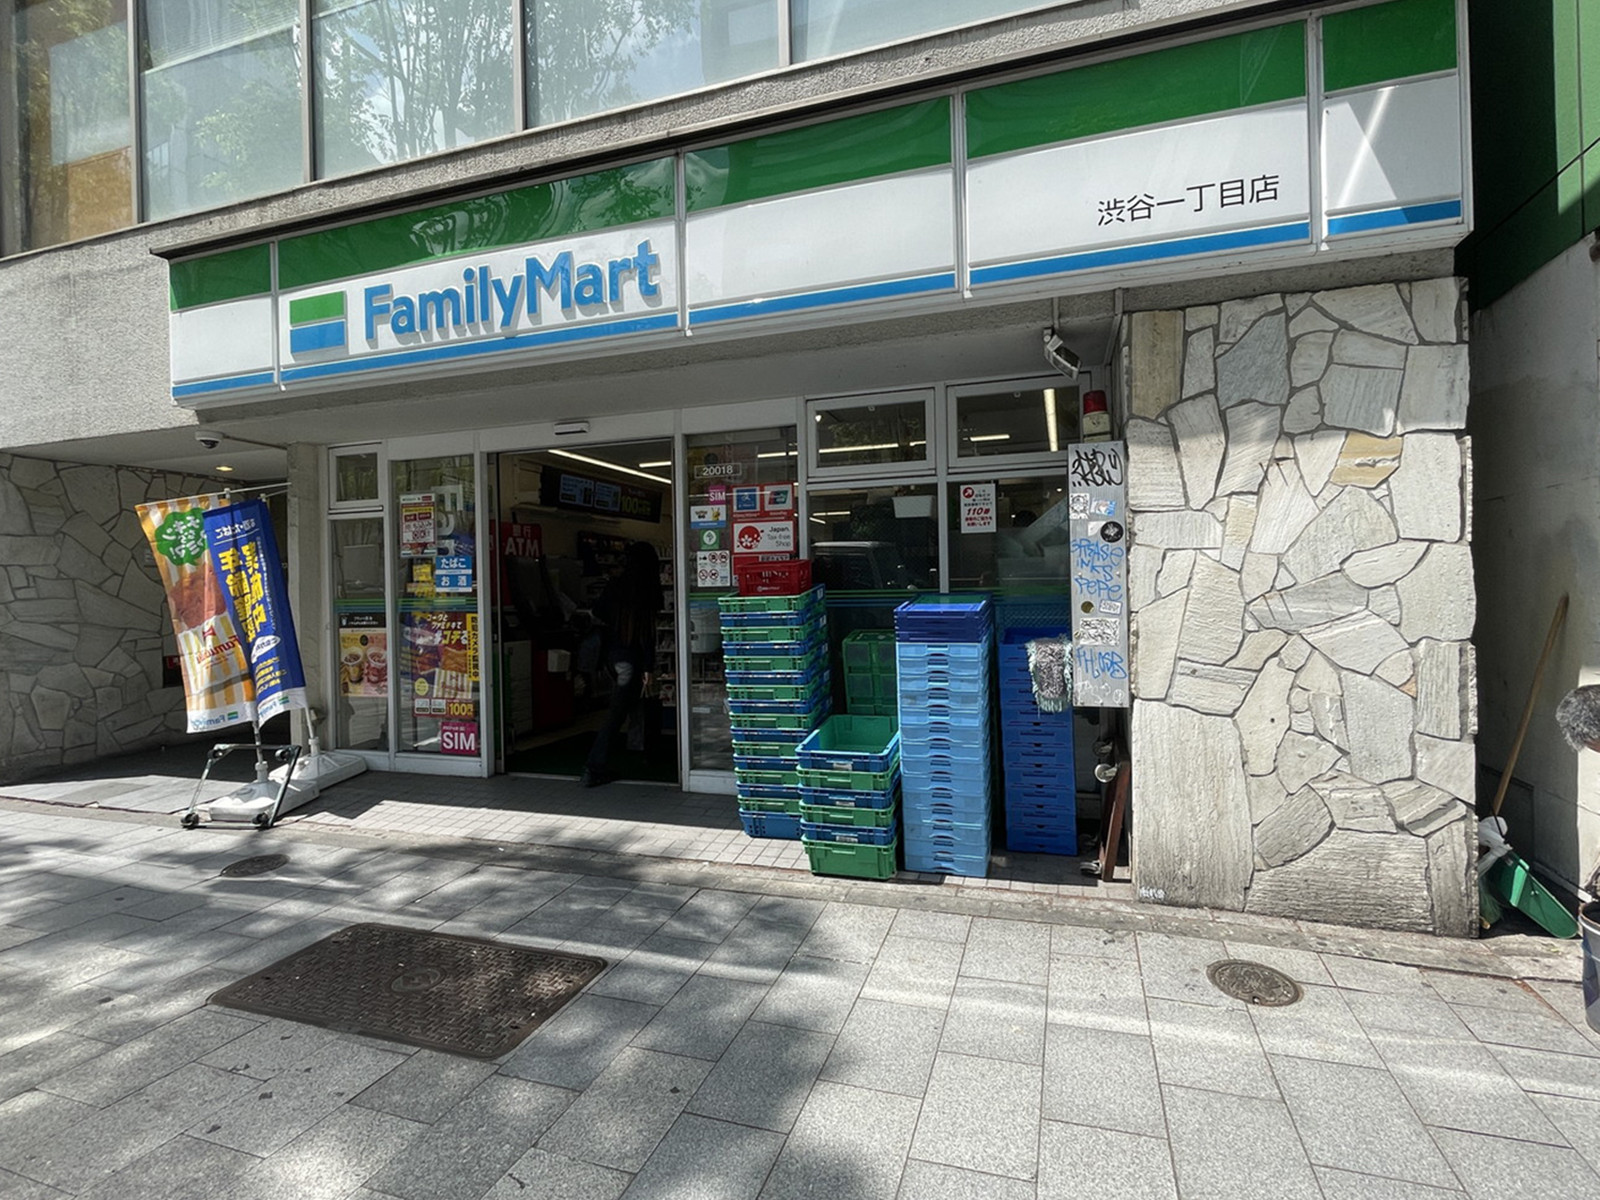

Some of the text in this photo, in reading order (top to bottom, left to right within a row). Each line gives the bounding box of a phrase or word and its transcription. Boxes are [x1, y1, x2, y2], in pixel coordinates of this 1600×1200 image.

[1098, 175, 1280, 226] 渋谷一丁目店
[364, 240, 659, 341] FamilyMart
[702, 465, 733, 476] 20018
[709, 492, 726, 502] SIM
[504, 536, 540, 558] ATM
[440, 557, 467, 569] たばこ
[442, 731, 475, 751] SIM
